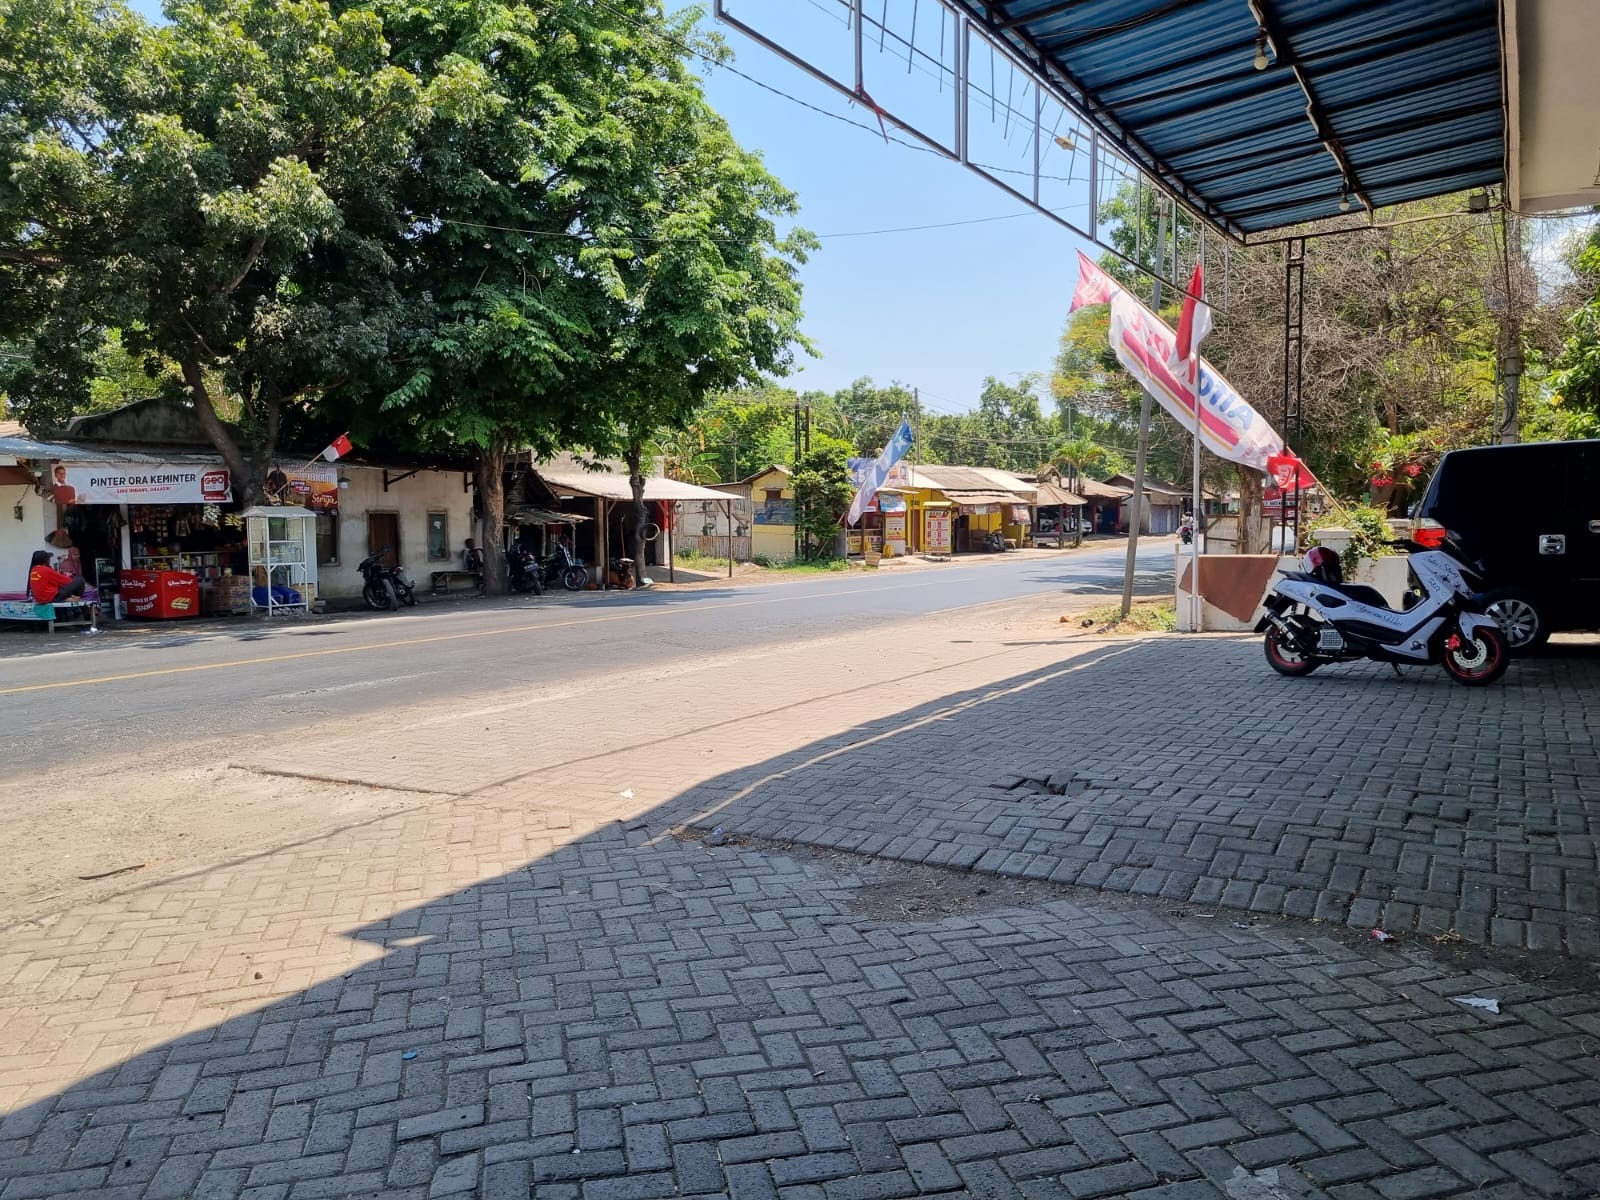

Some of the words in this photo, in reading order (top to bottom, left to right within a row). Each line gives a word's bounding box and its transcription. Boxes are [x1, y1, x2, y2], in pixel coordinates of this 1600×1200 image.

[90, 477, 126, 487] PINTER
[128, 475, 149, 485] ORA
[150, 473, 196, 484] KEMINTER
